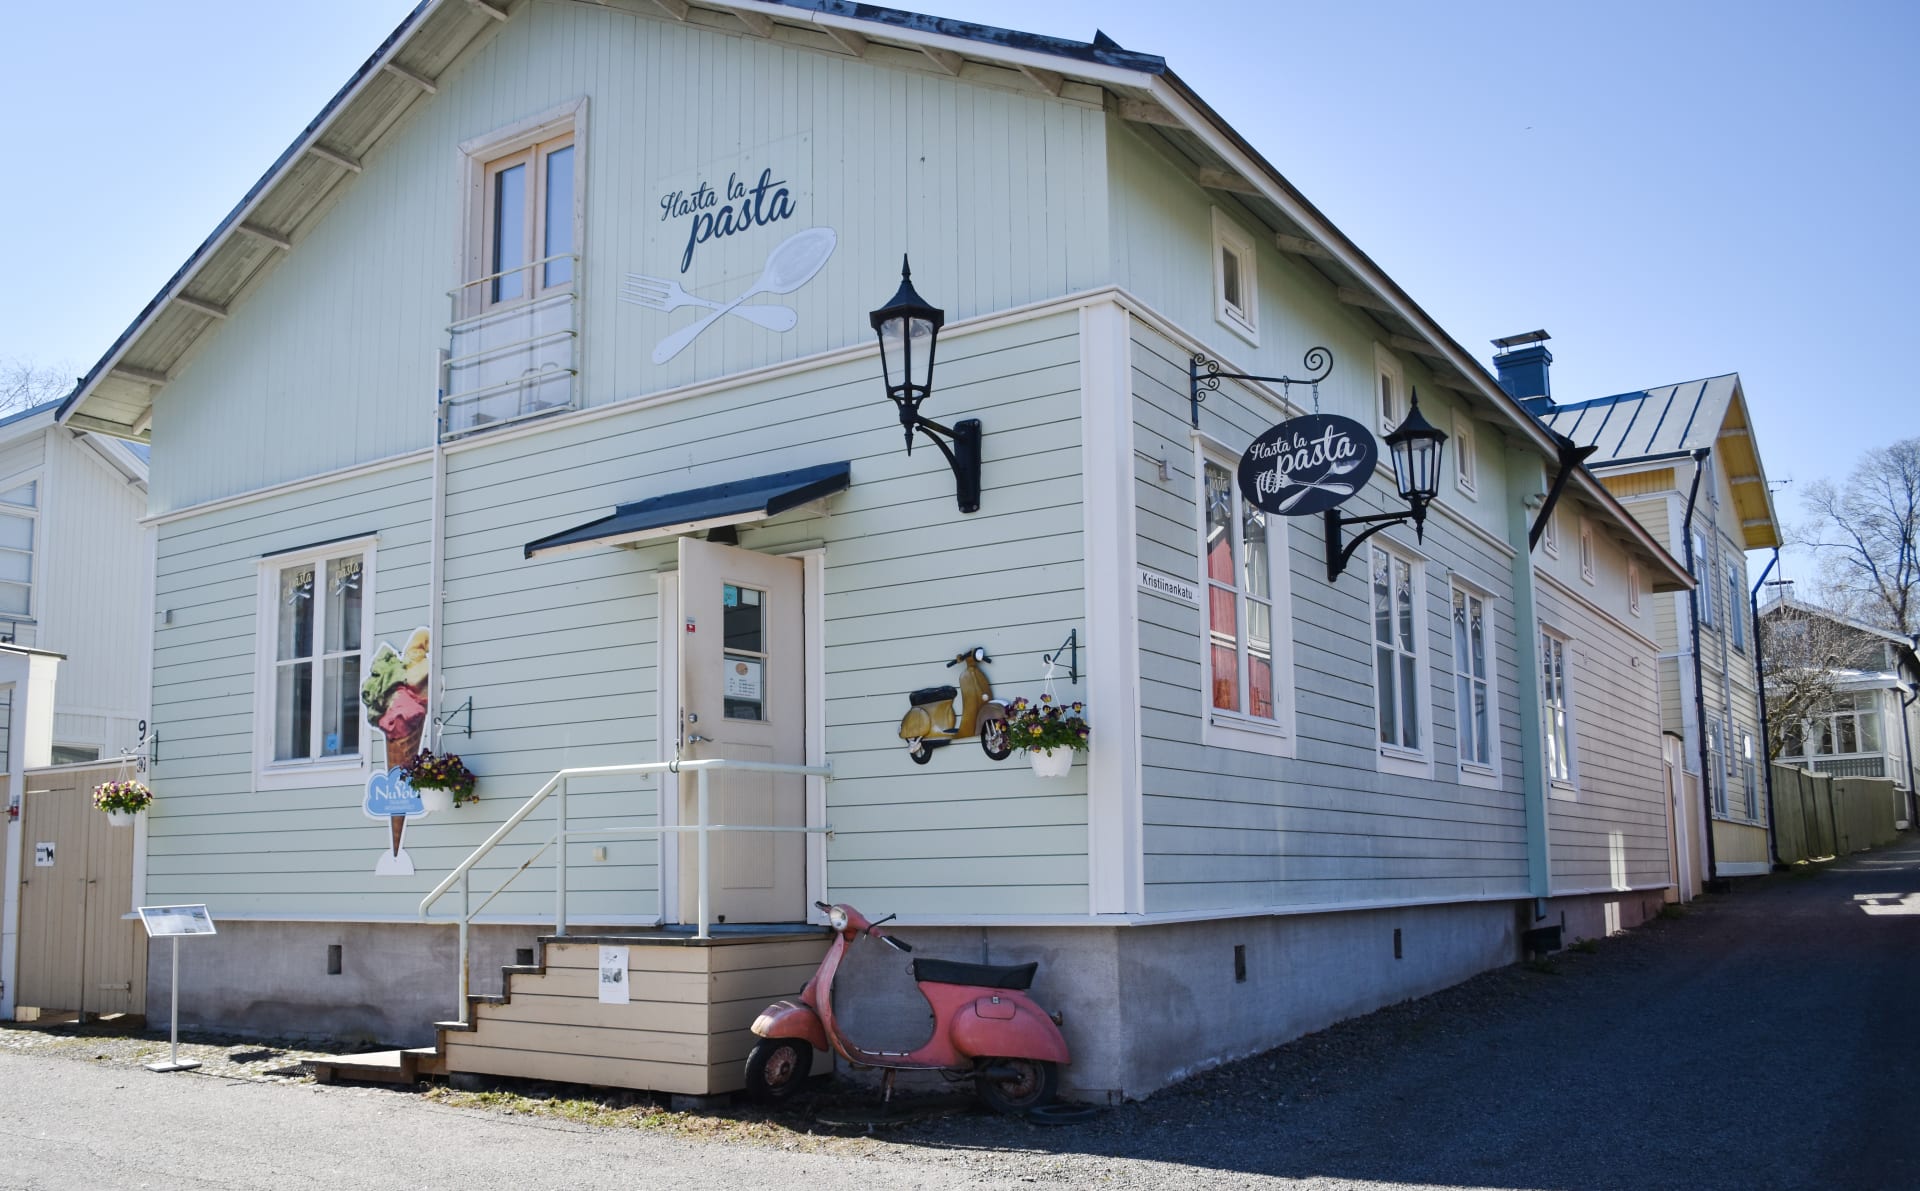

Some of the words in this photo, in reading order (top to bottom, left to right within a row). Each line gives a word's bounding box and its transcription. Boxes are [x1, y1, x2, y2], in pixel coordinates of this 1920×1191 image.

[660, 181, 718, 221] Hasta
[728, 172, 747, 201] la
[681, 168, 796, 273] pasta
[1250, 437, 1291, 461] Hasta
[1293, 432, 1308, 449] la
[1258, 425, 1357, 502] pasta
[1142, 572, 1193, 600] Kristiinankatu
[138, 719, 146, 741] 9
